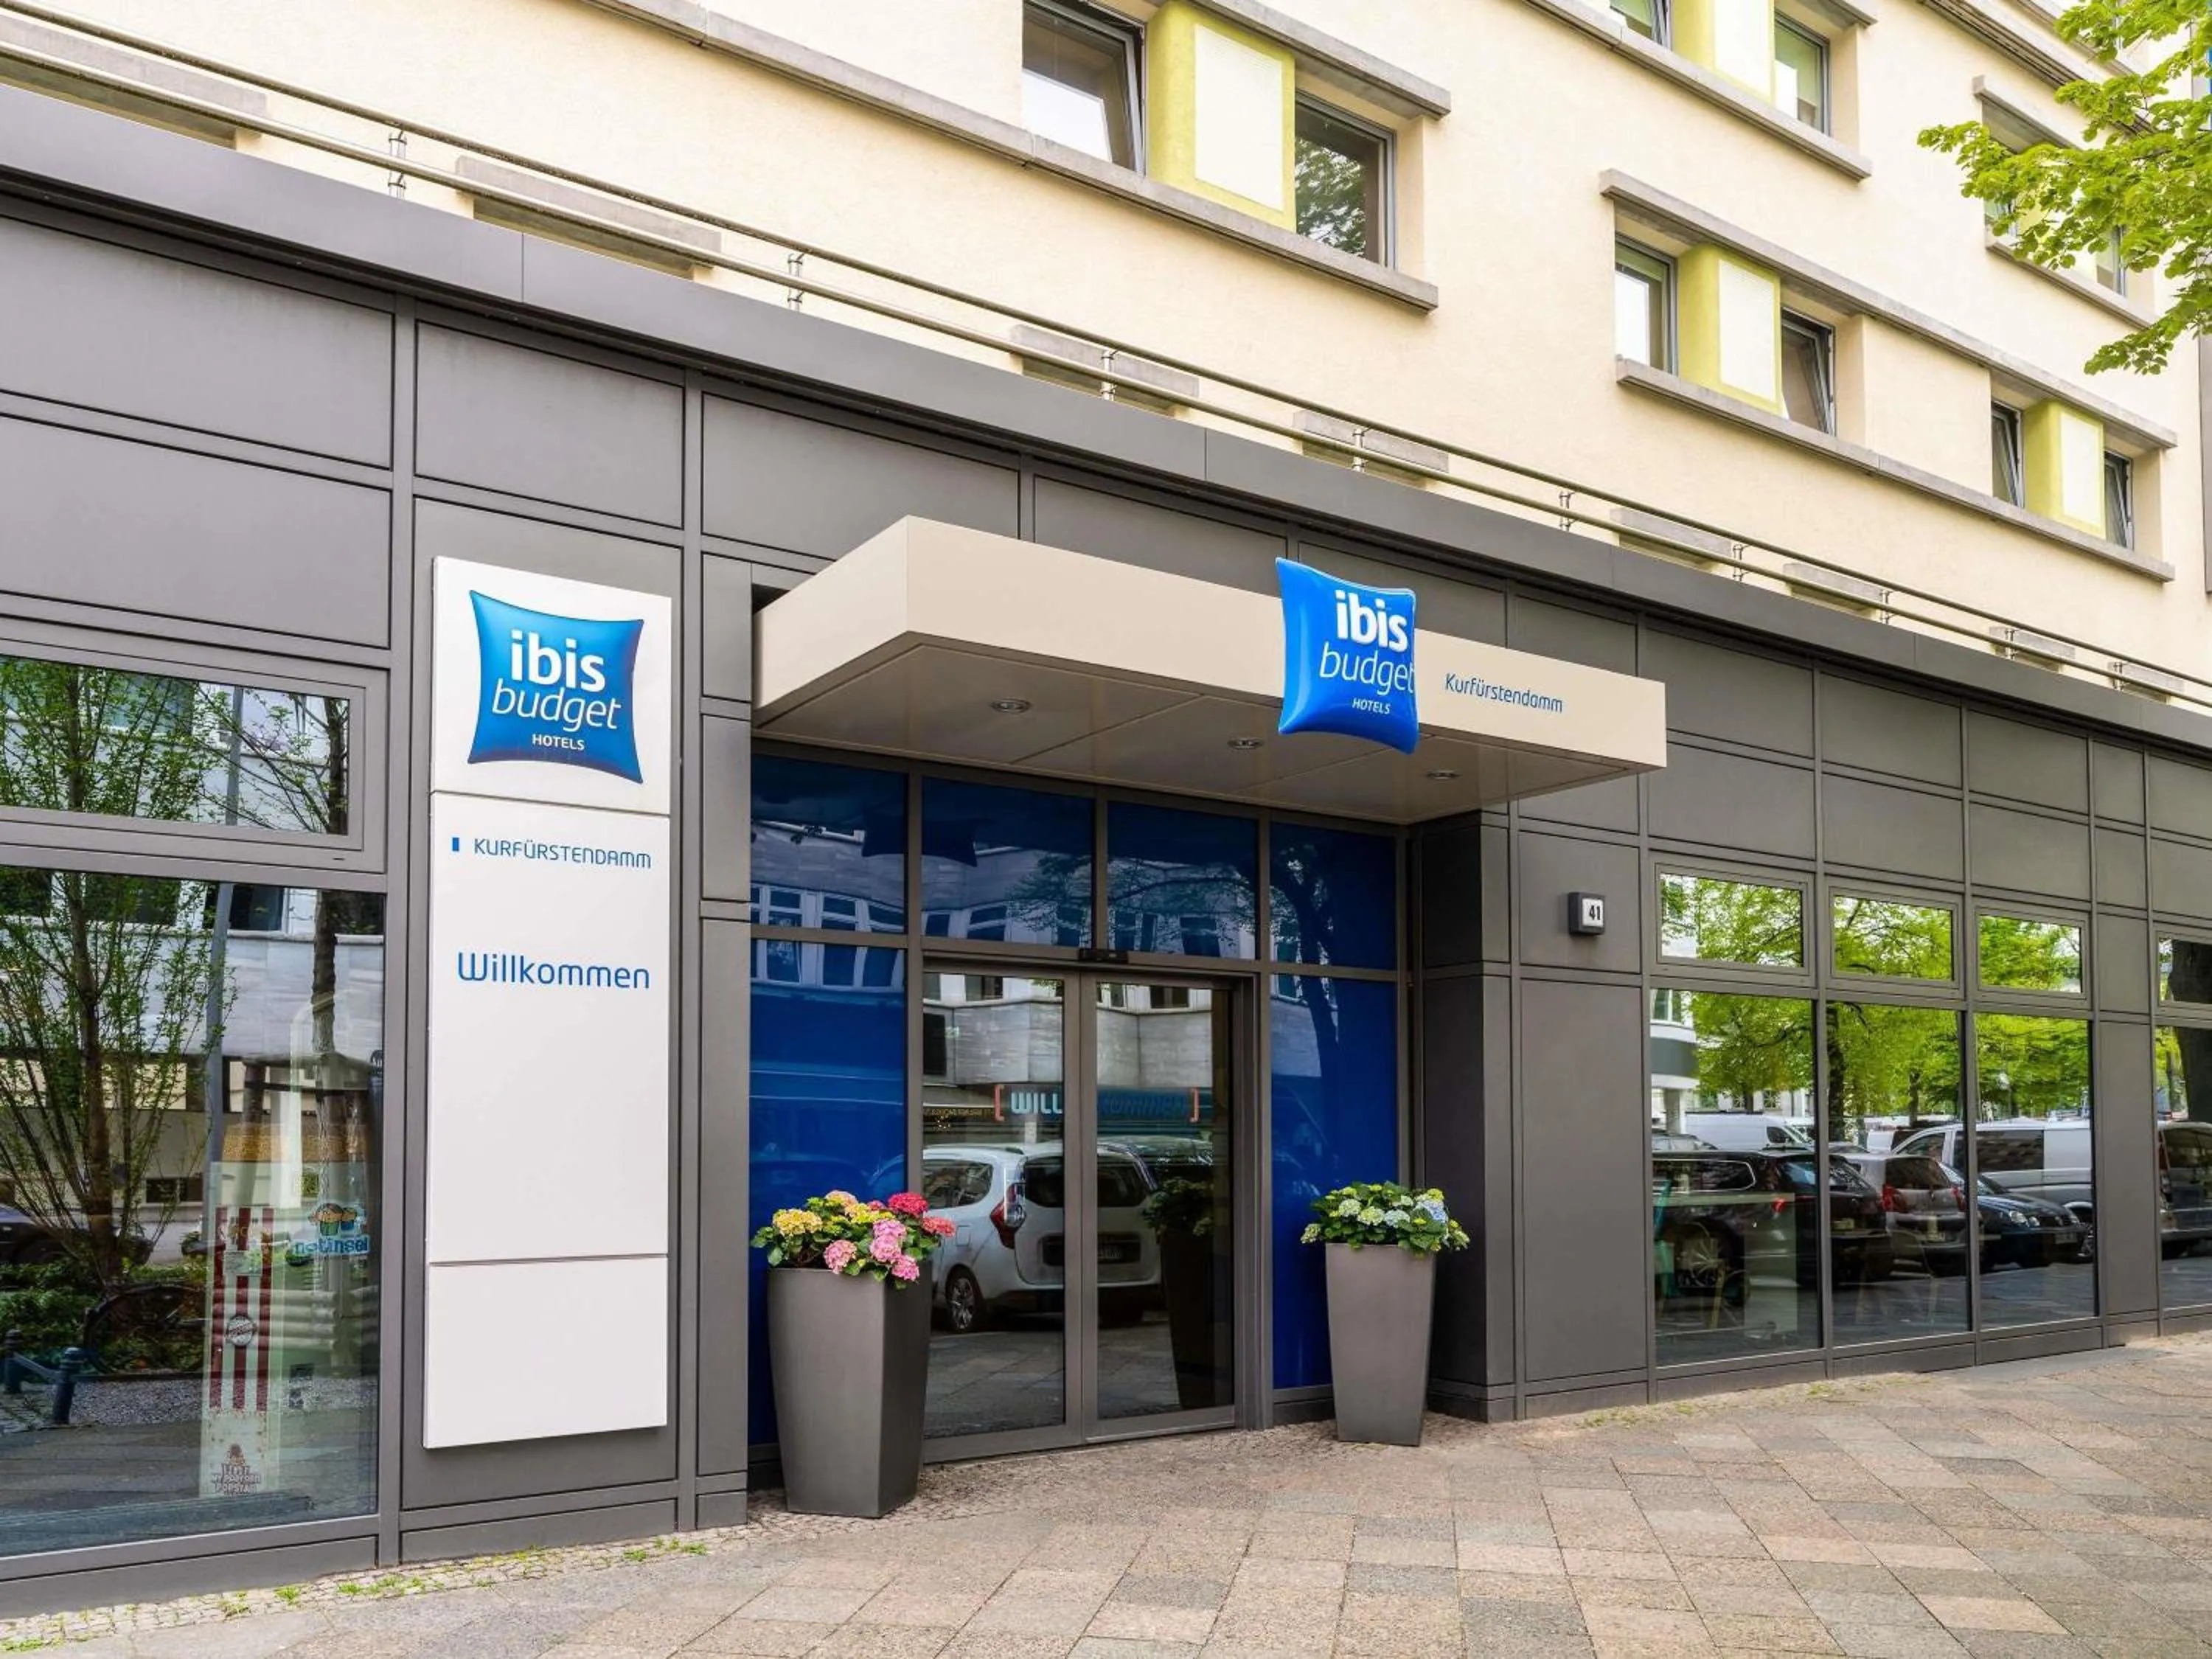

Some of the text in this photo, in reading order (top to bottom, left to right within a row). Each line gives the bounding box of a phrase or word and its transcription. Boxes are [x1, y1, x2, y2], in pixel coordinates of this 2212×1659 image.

[1335, 589, 1409, 653] ibis
[510, 628, 606, 692] ibis
[1319, 641, 1414, 695] budget
[492, 678, 621, 732] budget
[1352, 697, 1391, 714] HOTELS
[1445, 672, 1563, 714] Kurfürstendamm
[532, 734, 585, 751] HOTELS
[474, 837, 652, 869] KURFÜRSTENDAMM
[1589, 905, 1601, 921] 41
[457, 951, 650, 989] Willkommen
